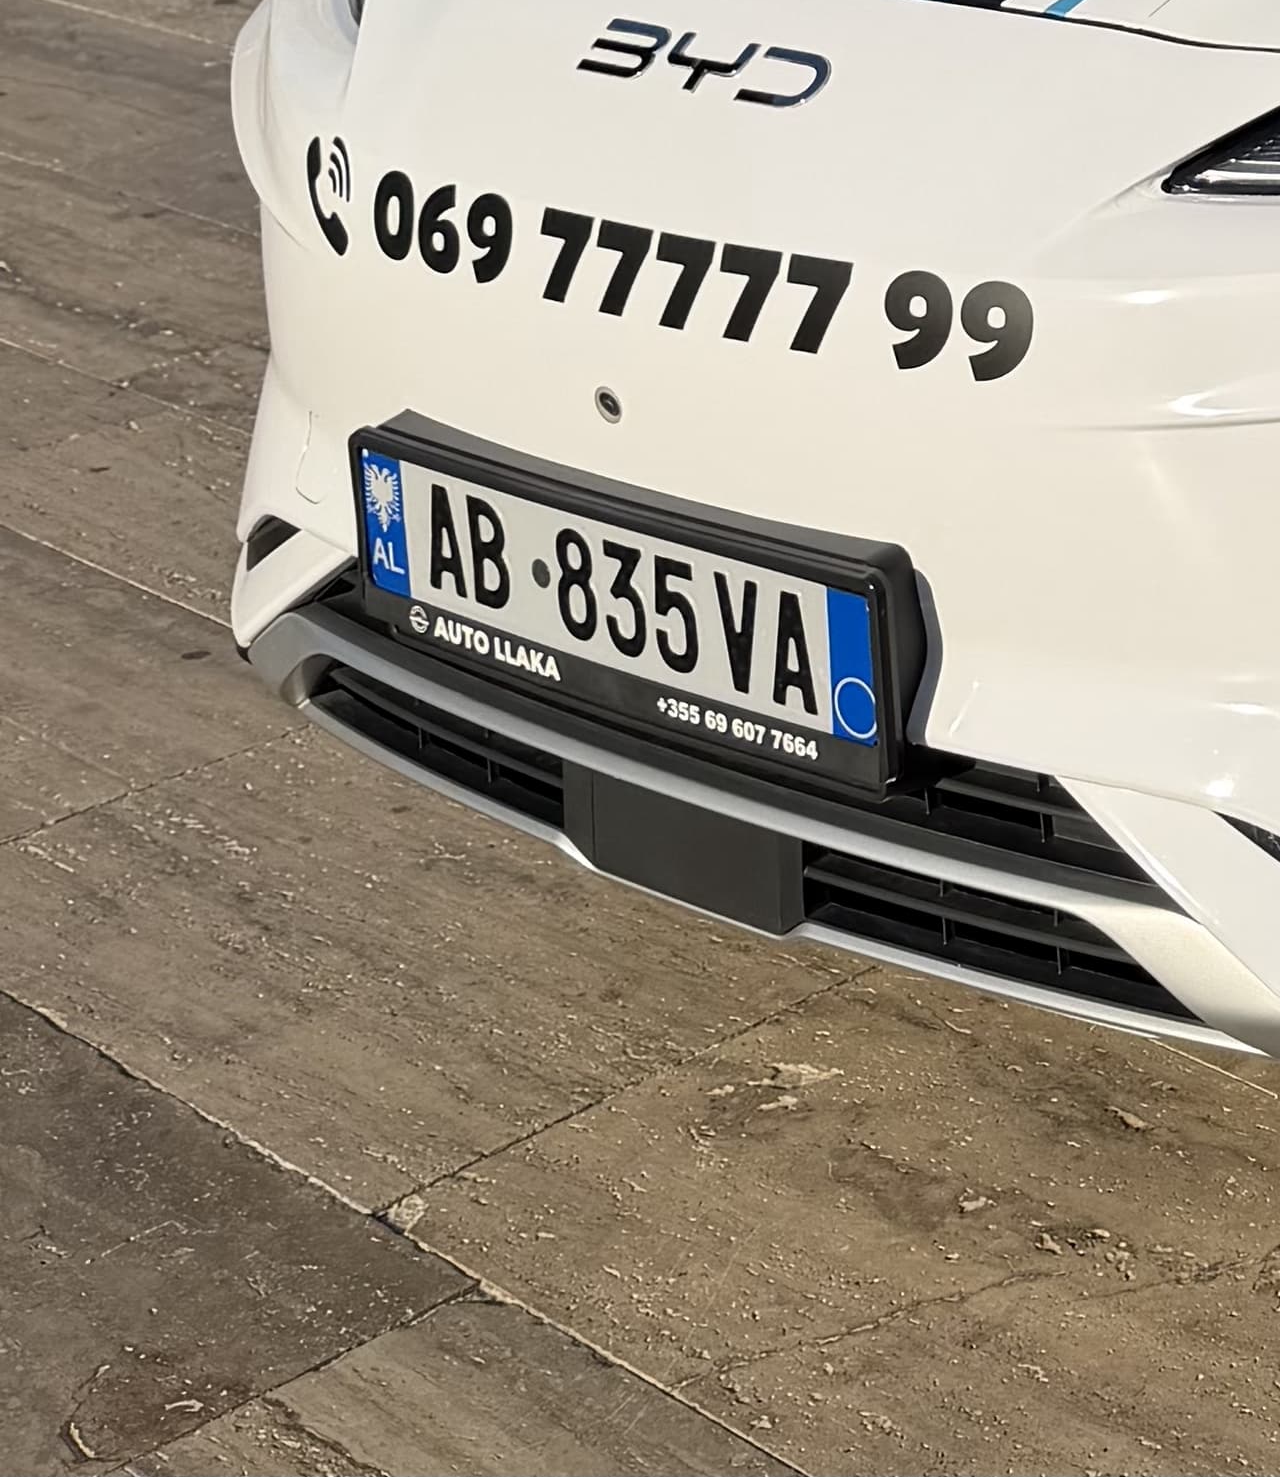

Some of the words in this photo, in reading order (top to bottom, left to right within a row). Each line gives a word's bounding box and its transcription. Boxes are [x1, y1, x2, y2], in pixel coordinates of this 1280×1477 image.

[576, 17, 832, 109] BYD
[373, 169, 513, 284] 069
[540, 206, 855, 354] 77777
[884, 269, 1035, 382] 99
[373, 537, 406, 575] AL
[429, 483, 512, 610] AB
[433, 616, 490, 655] AUTO
[493, 636, 562, 682] LLAKA
[656, 697, 701, 725] +355
[704, 710, 728, 733] 69
[731, 718, 766, 744] 607
[770, 729, 819, 760] 7664
